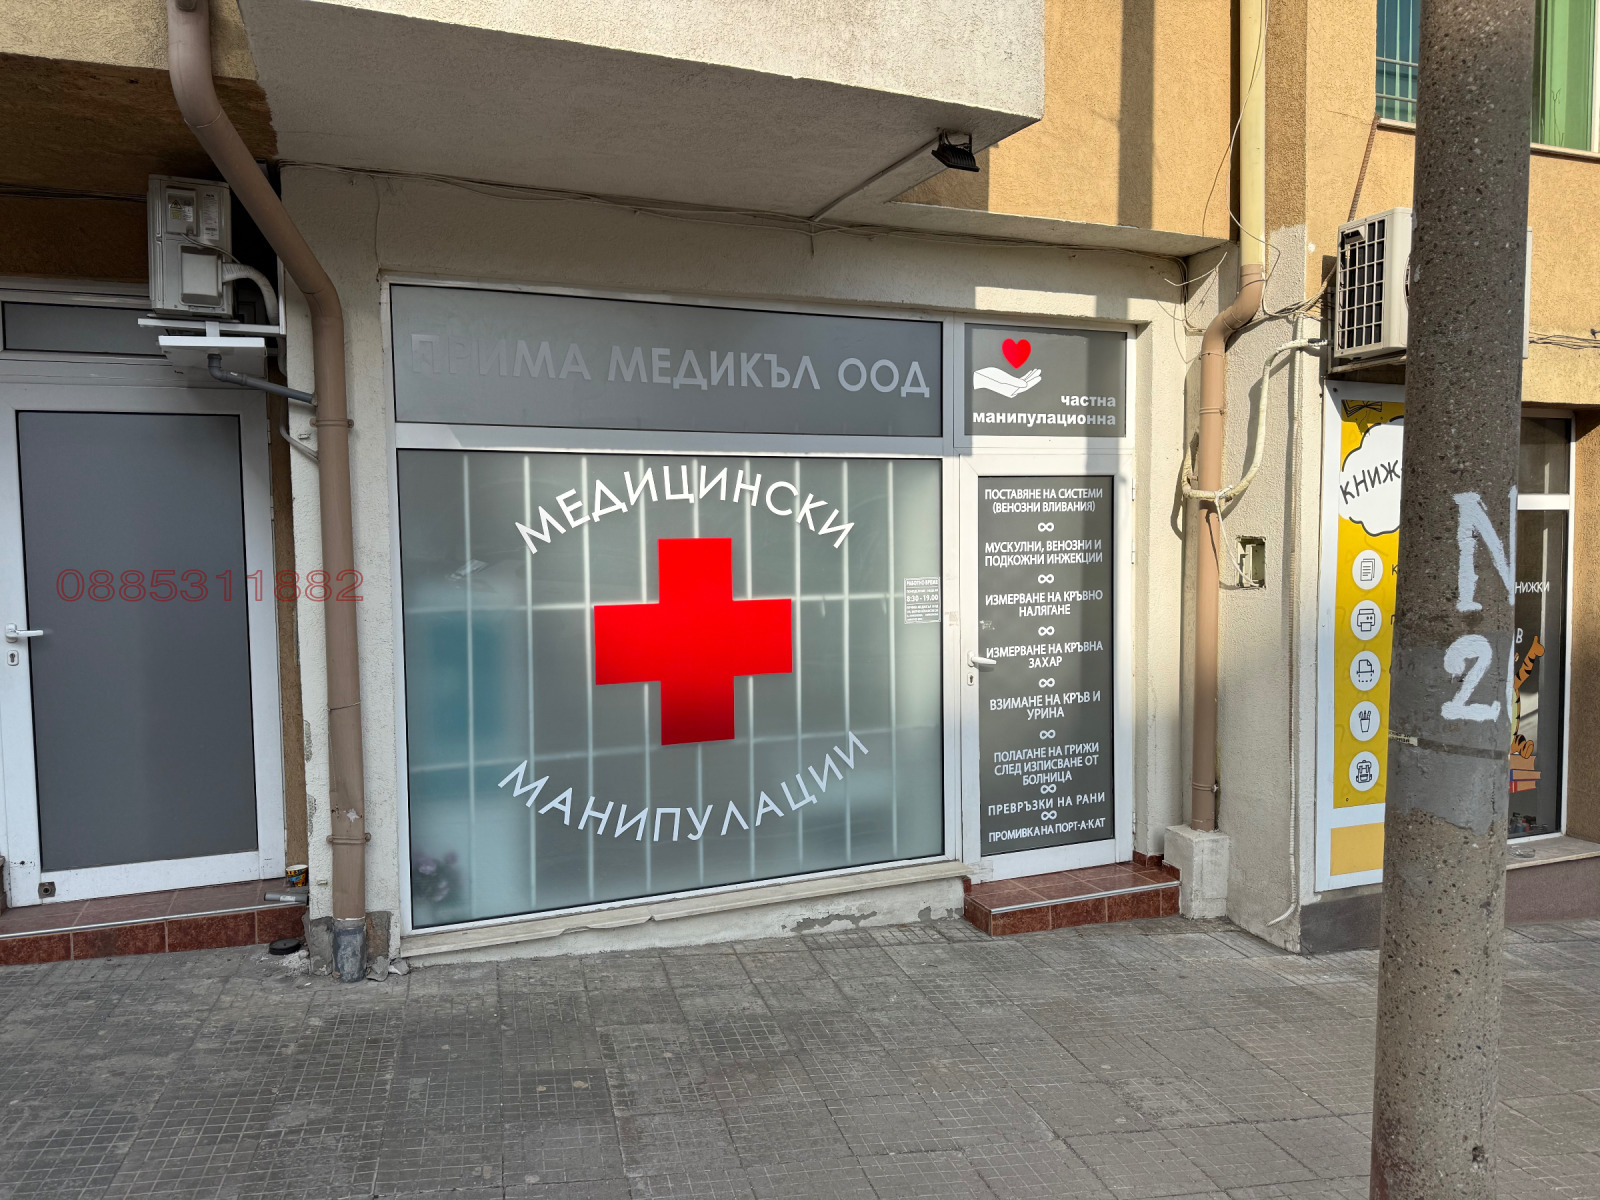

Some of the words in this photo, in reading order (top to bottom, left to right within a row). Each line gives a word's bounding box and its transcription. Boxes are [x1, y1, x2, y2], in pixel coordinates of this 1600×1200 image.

[411, 333, 592, 381] ПРИМА
[607, 345, 820, 391] МЕДИКЪЛ
[838, 357, 930, 398] ООД
[1061, 395, 1116, 407] частна
[973, 412, 1116, 427] манипулационна
[1340, 459, 1402, 505] КНИЖ
[984, 489, 1041, 500] ПОСТАВЯНЕ
[1043, 489, 1056, 499] НА
[1058, 488, 1103, 499] СИСТЕМИ
[515, 465, 855, 555] МЕДИЦИНСКИ
[992, 502, 1041, 514] (ВЕНОЗНИ
[1042, 501, 1095, 512] ВЛИВАНИЯ)
[985, 541, 1044, 553] МУСКУЛНИ,
[1046, 540, 1092, 551] ВЕНОЗНИ
[1094, 539, 1101, 550] И
[985, 554, 1045, 568] ПОДКОЖНИ
[1046, 552, 1103, 565] ИНЖЕКЦИИ
[1515, 580, 1550, 594] НИЖКИ
[985, 592, 1045, 606] ИЗМЕРВАНЕ
[1047, 591, 1062, 602] НА
[1063, 590, 1103, 602] КРЪВНО
[1019, 604, 1070, 617] НАЛЯГАНЕ
[986, 644, 1046, 659] ИЗМЕРВАНЕ
[1048, 643, 1063, 654] НА
[1064, 641, 1103, 653] КРЪВНА
[1028, 656, 1063, 669] ЗАХАР
[1441, 634, 1515, 723] 2
[990, 695, 1043, 710] ВЗИМАНЕ
[1045, 694, 1060, 706] НА
[1063, 692, 1091, 705] КРЪВ
[1093, 691, 1101, 702] И
[1027, 706, 1065, 720] УРИНА
[994, 748, 1046, 763] ПОЛАГАНЕ
[1048, 746, 1062, 758] НА
[1064, 742, 1099, 756] ГРИЖИ
[994, 763, 1022, 776] СЛЕД
[1024, 757, 1083, 773] ИЗПИСВАНЕ
[1085, 754, 1099, 765] ОТ
[498, 730, 869, 842] МАНИПУЛАЦИИ
[1023, 771, 1072, 786] БОЛНИЦА
[988, 797, 1054, 816] ПРЕВРЪЗКИ
[1057, 795, 1072, 808] НА
[1077, 792, 1105, 805] РАНИ
[1055, 818, 1106, 833] ПОРТ-А-КАТ
